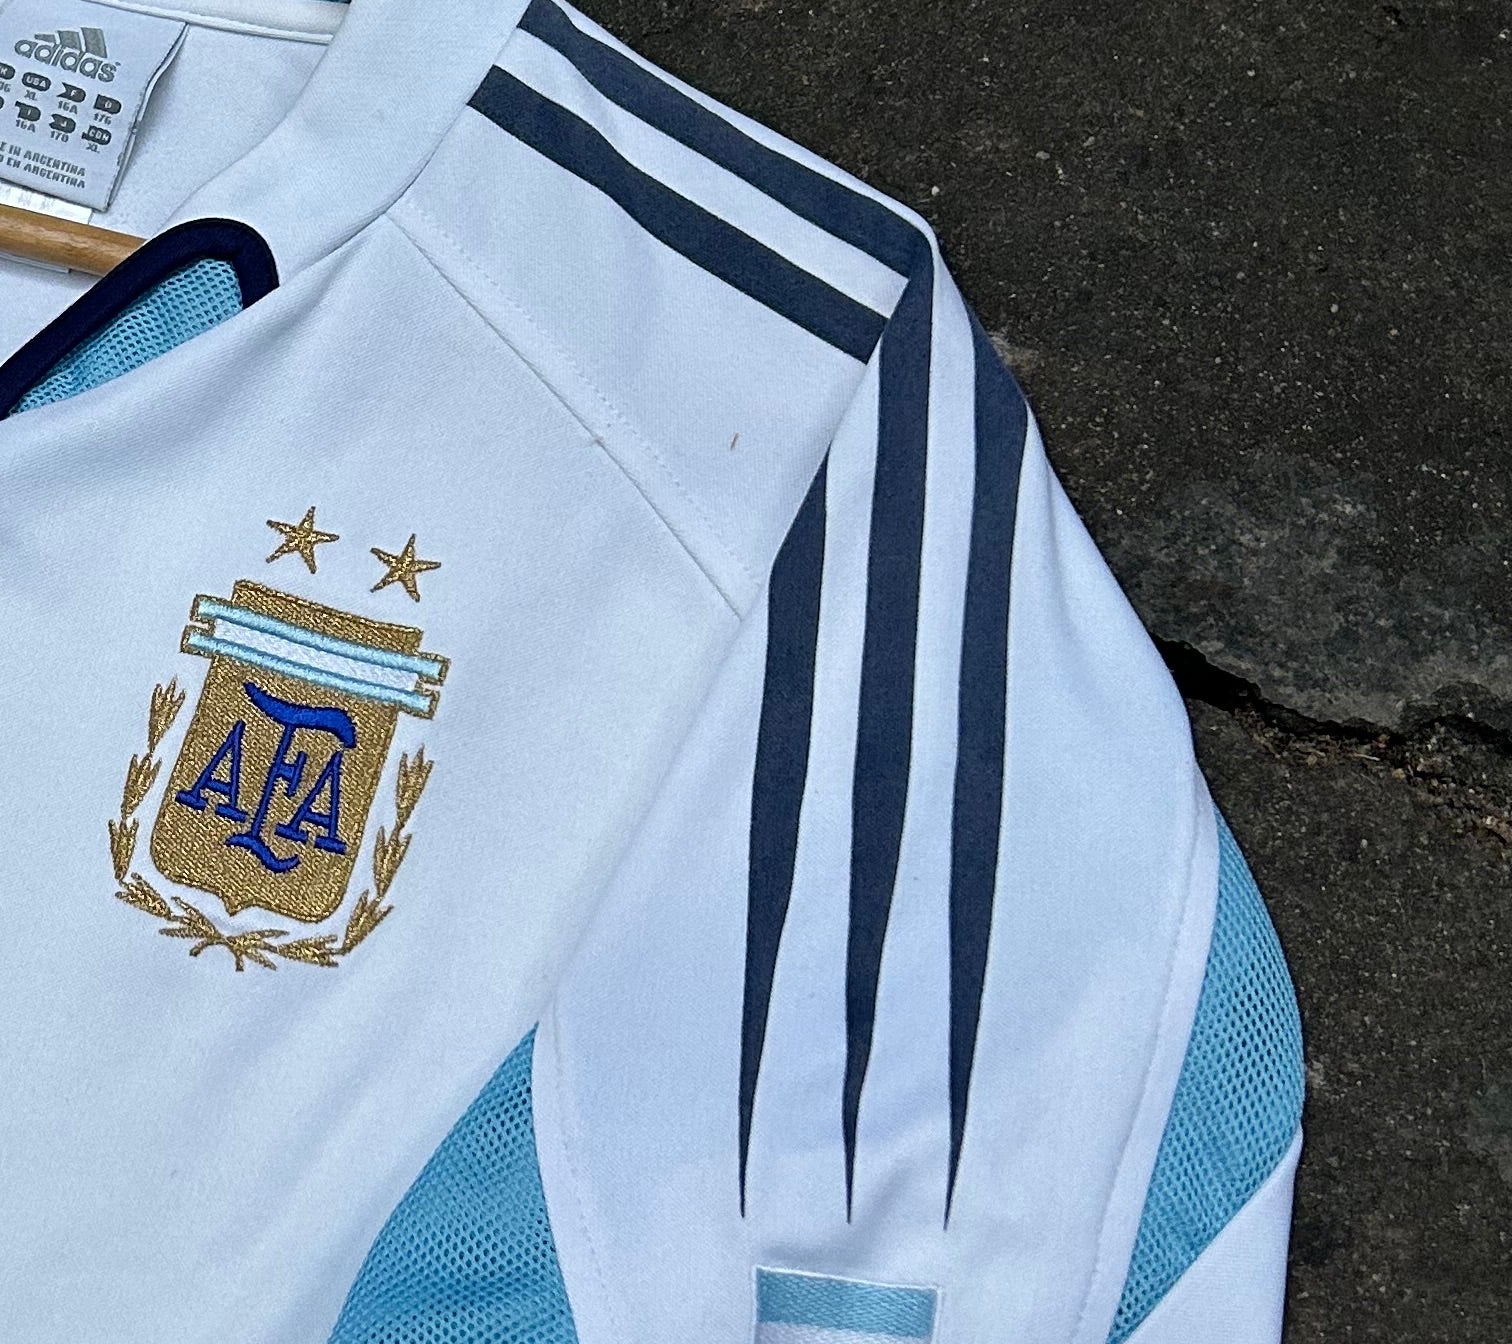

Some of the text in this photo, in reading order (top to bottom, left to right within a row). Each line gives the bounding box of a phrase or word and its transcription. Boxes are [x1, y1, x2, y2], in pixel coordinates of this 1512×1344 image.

[14, 39, 118, 83] adidas
[26, 75, 47, 88] USA
[6, 157, 21, 169] EN
[23, 163, 85, 189] ARGENTINA
[8, 144, 22, 156] IN
[23, 150, 86, 177] ARGENTINA
[175, 681, 358, 874] AFA
